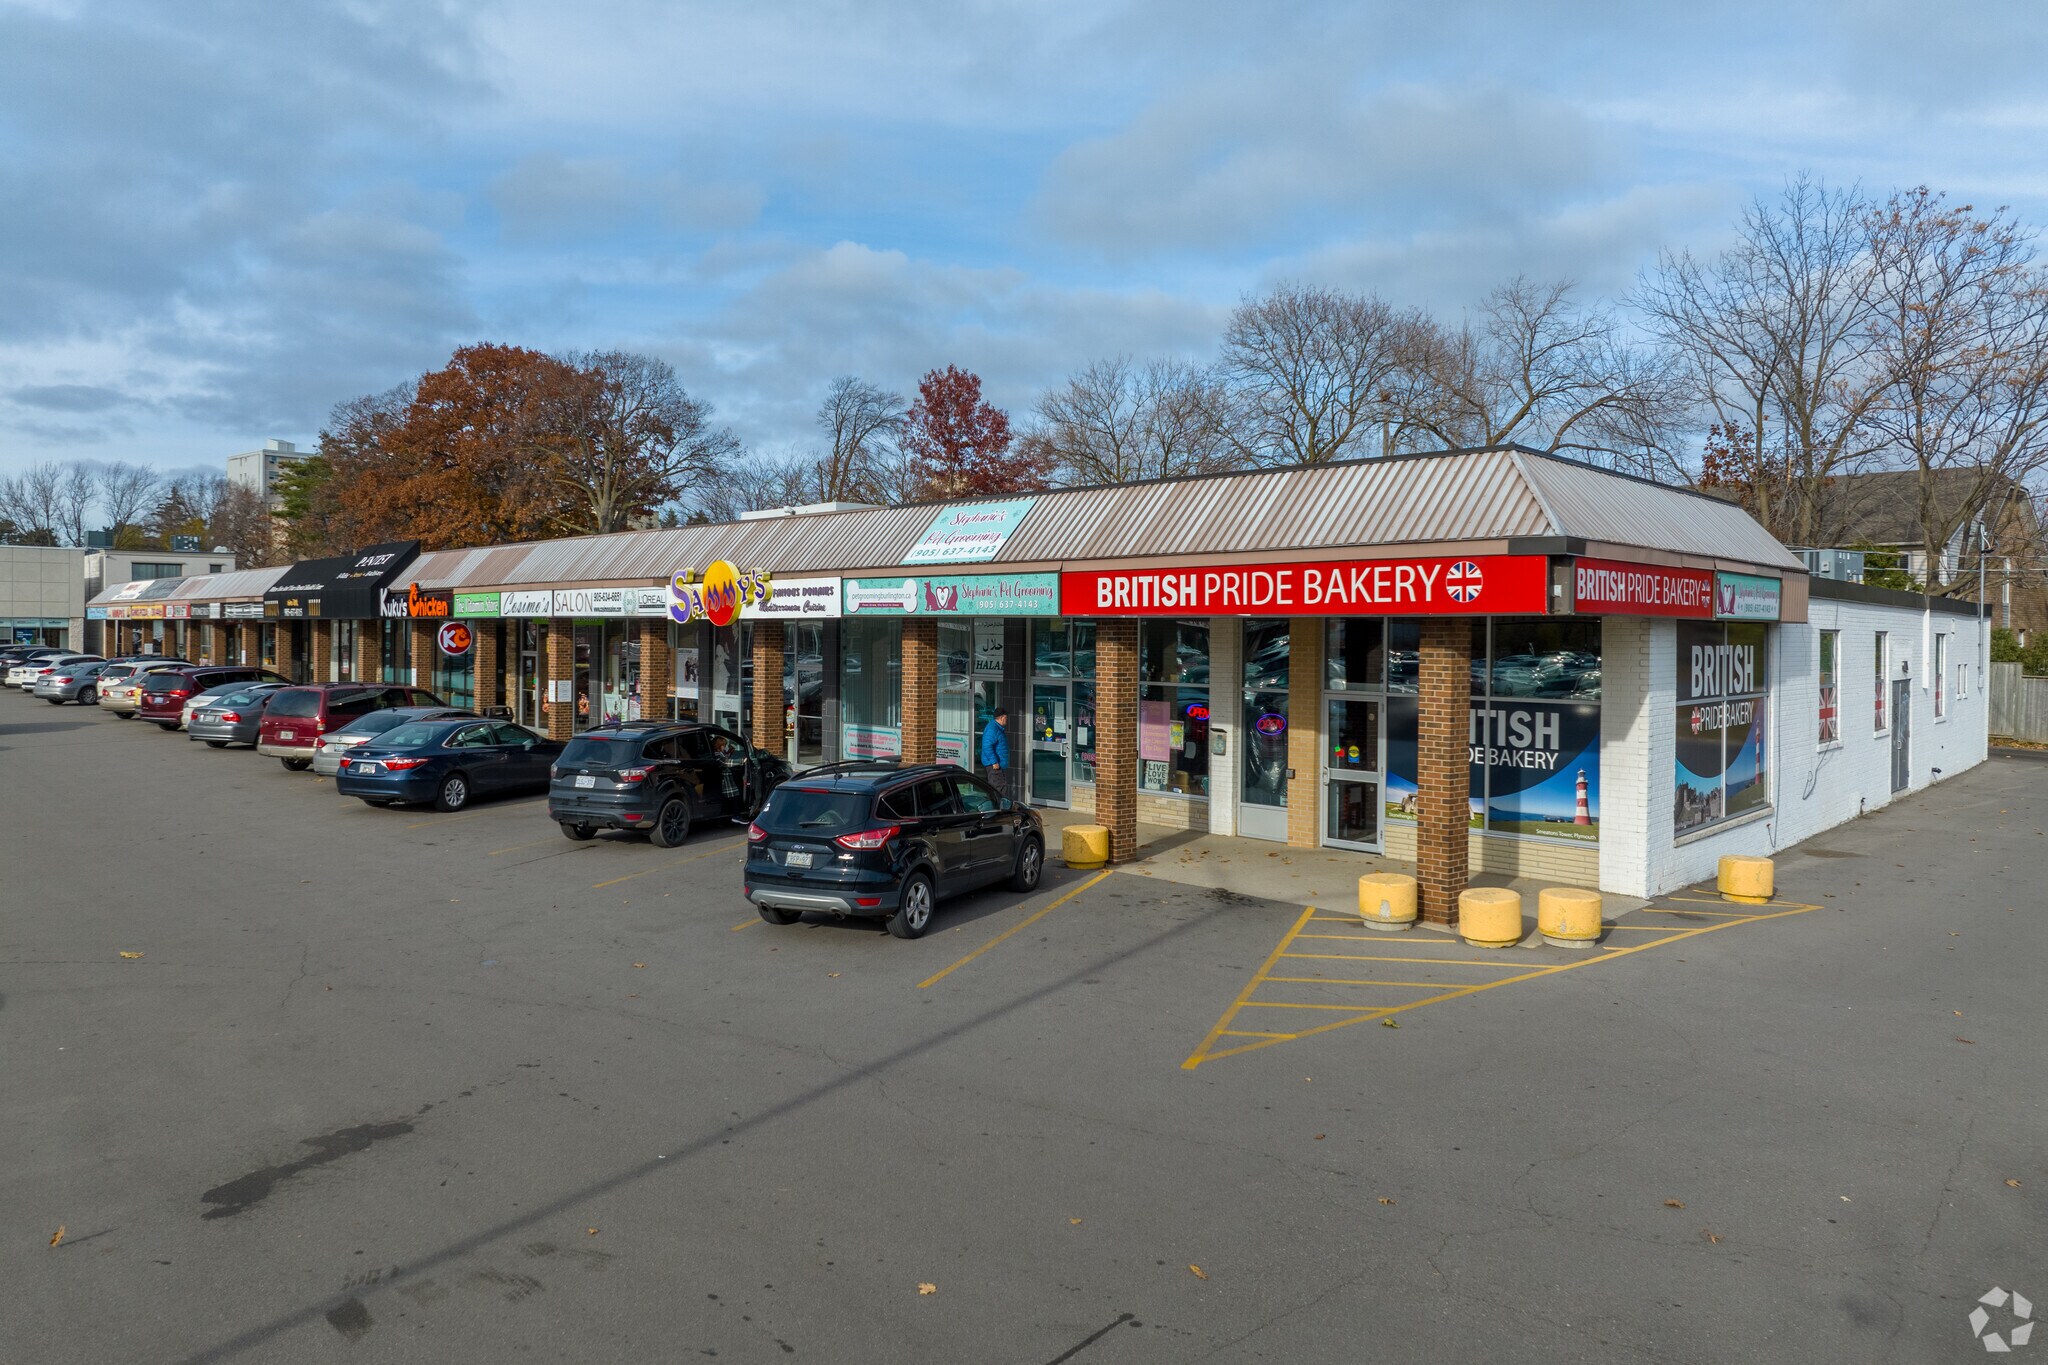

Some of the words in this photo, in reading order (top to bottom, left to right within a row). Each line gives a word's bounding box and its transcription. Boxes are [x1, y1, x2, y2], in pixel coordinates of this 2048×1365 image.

[949, 510, 1006, 527] Stephanie's
[923, 530, 945, 546] Pet
[944, 529, 1002, 546] Grooming
[911, 548, 941, 558] (905)
[942, 545, 997, 556] 637-4143
[773, 587, 800, 598] FAMOUS
[961, 583, 998, 600] Stephanie's
[1000, 580, 1012, 598] Pet
[1014, 580, 1053, 600] Grooming
[1097, 574, 1198, 608] BRITISH
[1205, 571, 1293, 606] PRIDE
[1304, 564, 1441, 604] BAKERY
[1577, 567, 1626, 602] BRITISH
[1628, 572, 1661, 604] PRIDE
[1663, 576, 1702, 607] BAKERY
[380, 588, 407, 617] Kuku's
[408, 582, 448, 617] Chicken
[503, 592, 550, 615] Cosimo's
[555, 592, 593, 612] SALON
[852, 592, 911, 601] petgroomingburlington.ca
[976, 600, 997, 609] (905)
[999, 599, 1038, 609] 637-4143
[1188, 706, 1210, 718] OPEN
[1700, 705, 1723, 732] PRIDE
[1726, 701, 1754, 727] BAKERY
[1258, 718, 1284, 730] OPEN
[1469, 708, 1560, 750] ITISH
[1148, 763, 1166, 771] LIVE
[1490, 750, 1559, 770] BAKERY
[1147, 770, 1166, 778] LOVE
